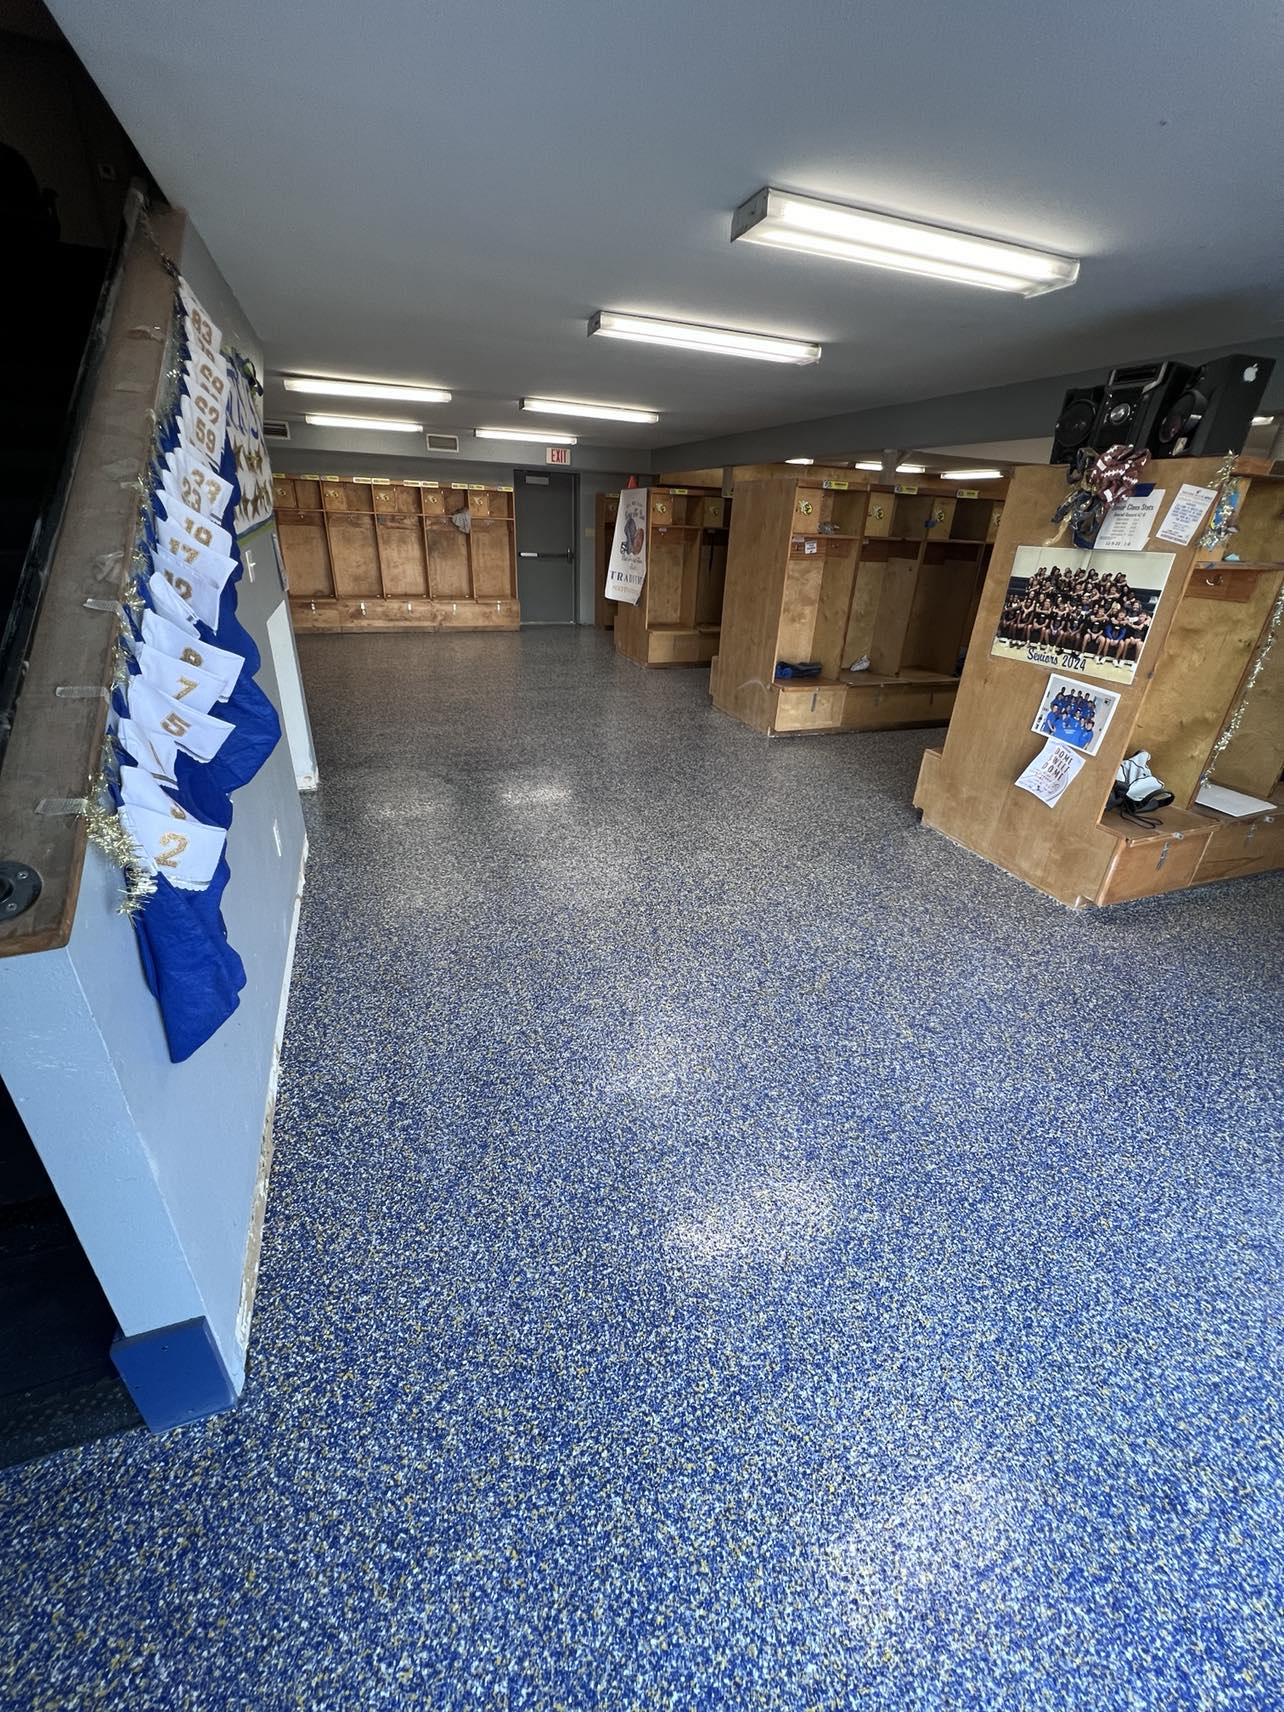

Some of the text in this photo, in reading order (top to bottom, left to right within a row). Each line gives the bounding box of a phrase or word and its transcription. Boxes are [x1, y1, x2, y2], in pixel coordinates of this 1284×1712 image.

[196, 417, 216, 454] 59
[551, 448, 567, 463] EXIT
[1141, 503, 1154, 511] Stats
[1027, 648, 1087, 672] Seniors 2024
[174, 676, 198, 700] 7
[161, 712, 191, 737] 5
[155, 831, 188, 869] 2
